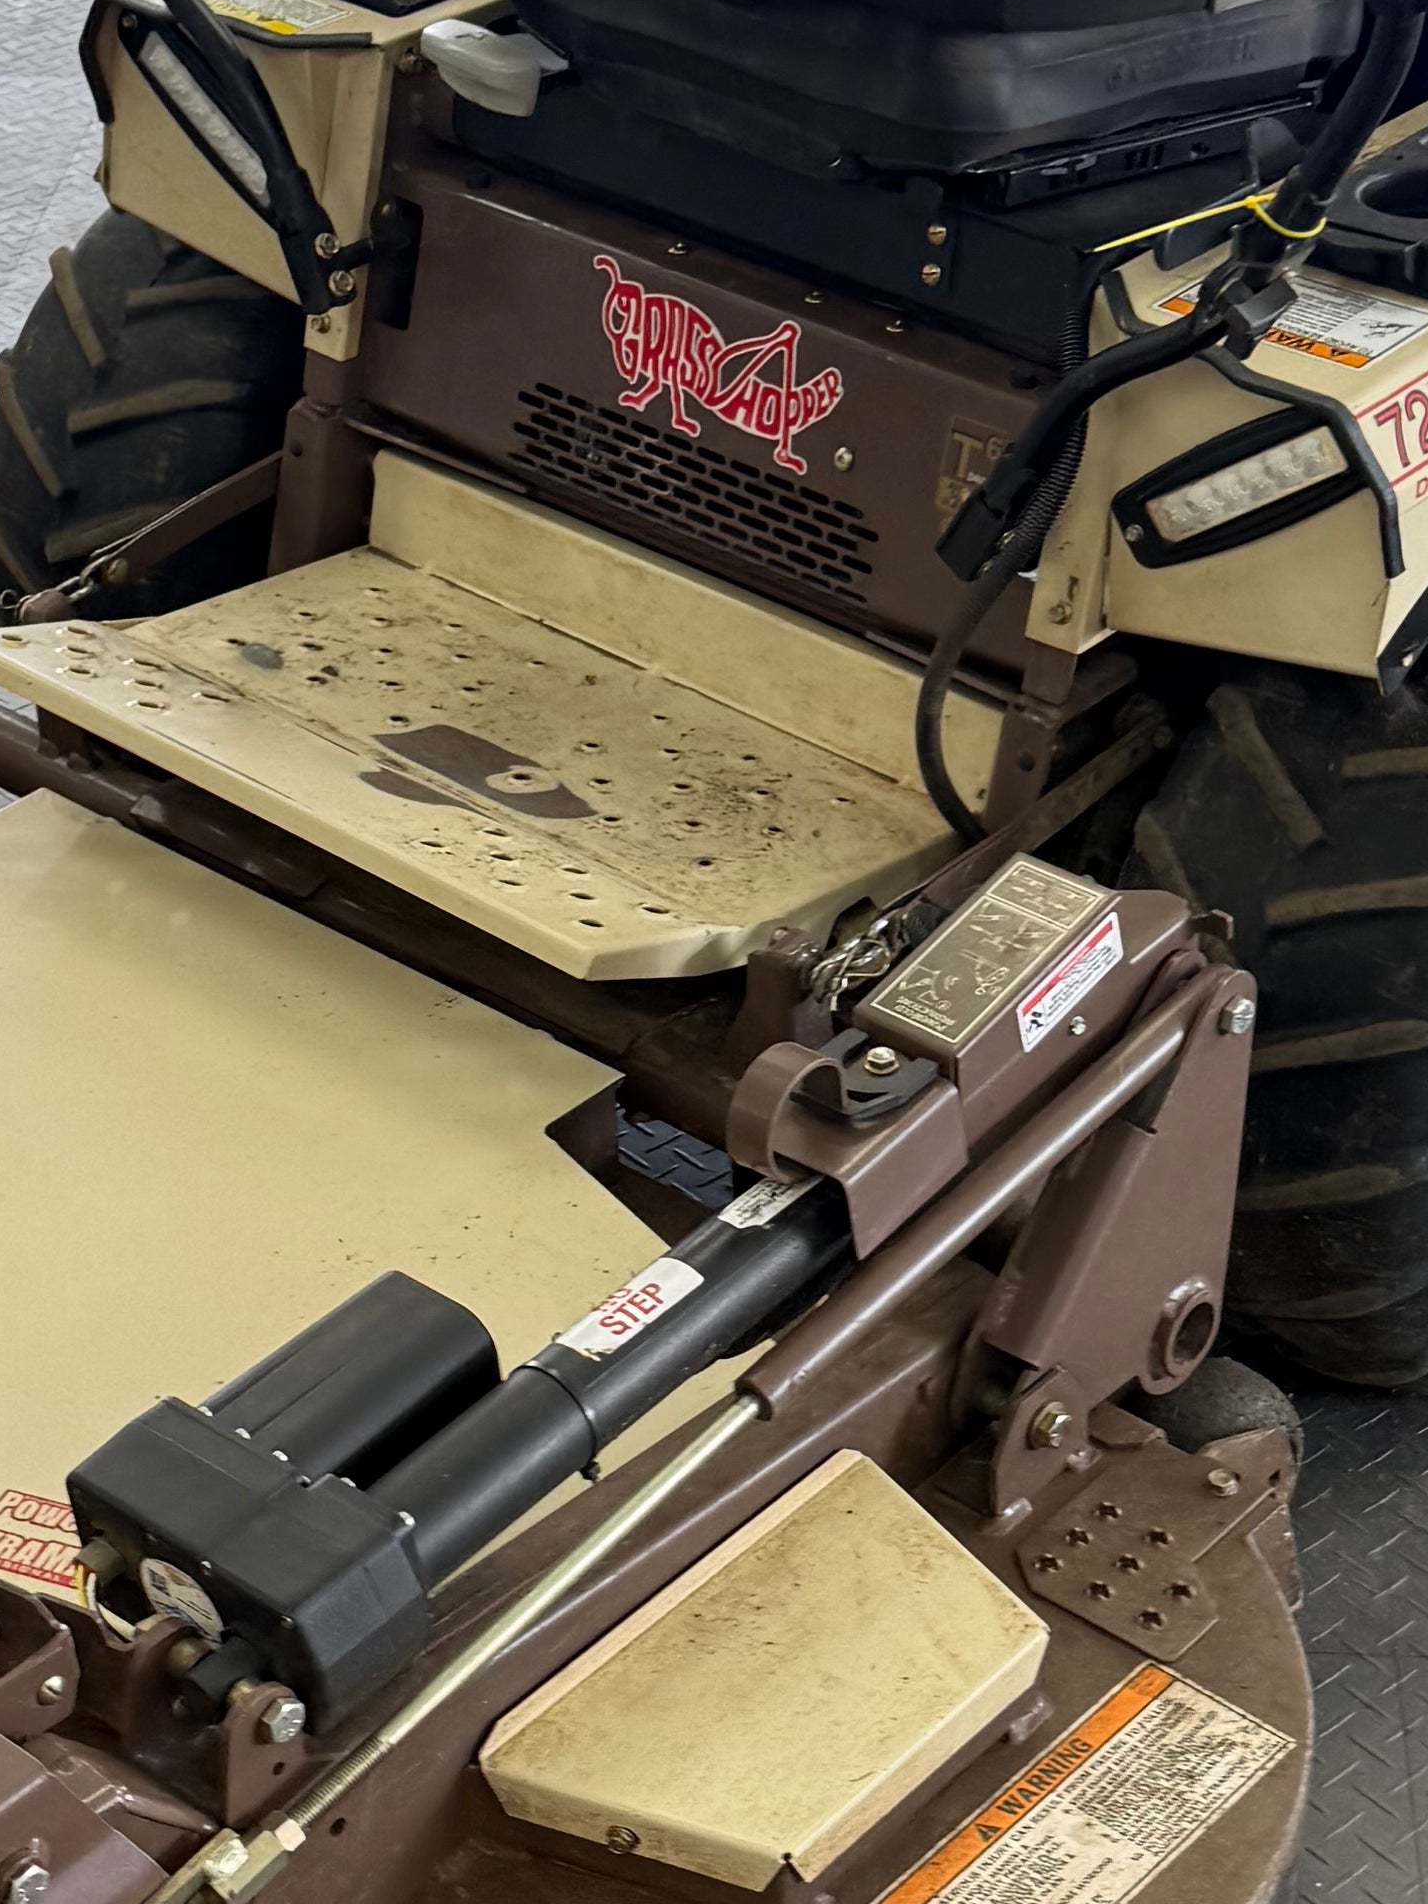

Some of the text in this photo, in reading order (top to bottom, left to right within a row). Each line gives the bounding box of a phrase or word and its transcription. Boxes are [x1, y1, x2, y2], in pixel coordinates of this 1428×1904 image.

[612, 280, 844, 446] GRASSHOPPER
[598, 1282, 665, 1337] STEP
[995, 1735, 1094, 1818] WARNING
